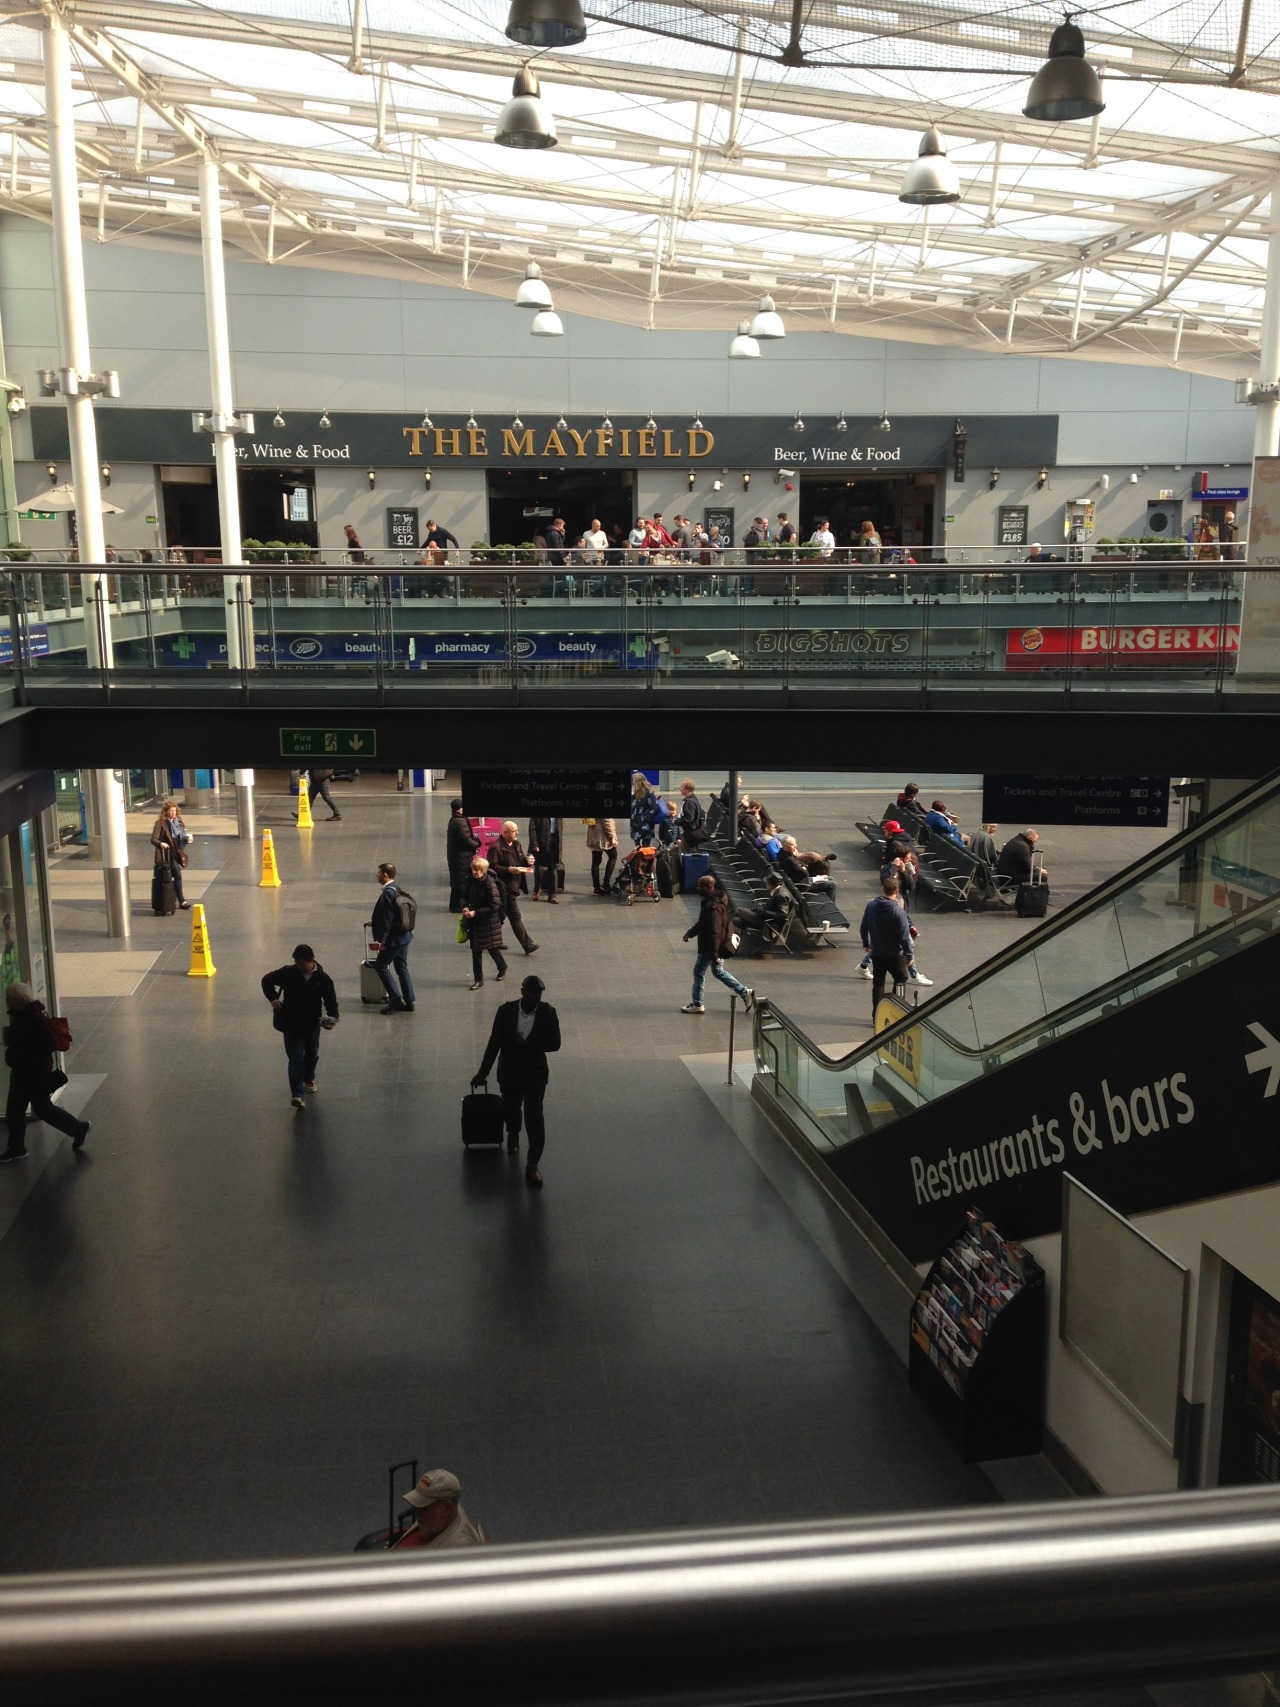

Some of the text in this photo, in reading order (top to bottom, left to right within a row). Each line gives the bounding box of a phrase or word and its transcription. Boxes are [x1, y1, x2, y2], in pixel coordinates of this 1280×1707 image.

[402, 428, 715, 457] THE MAYFIELD
[252, 443, 292, 458] Wine
[296, 444, 309, 458] &
[312, 444, 351, 459] Food
[774, 447, 901, 463] Beer, Wine & Food
[392, 525, 412, 534] BEER
[397, 534, 414, 546] £12
[757, 633, 910, 653] BIGSHOTS
[1023, 637, 1042, 647] KING
[1080, 628, 1239, 650] BURGER KIN
[435, 642, 490, 654] pharmacy
[558, 641, 597, 653] beauty
[293, 733, 312, 742] Fire
[294, 743, 312, 751] exit
[480, 781, 590, 791] Tickets and Travel Centre
[1002, 786, 1122, 798] Tickets and Travel Centre
[521, 798, 564, 807] Platforms
[571, 799, 581, 807] to
[584, 798, 589, 807] 7
[1074, 805, 1121, 815] Platforms
[910, 1072, 1195, 1205] Restaurants & bars
